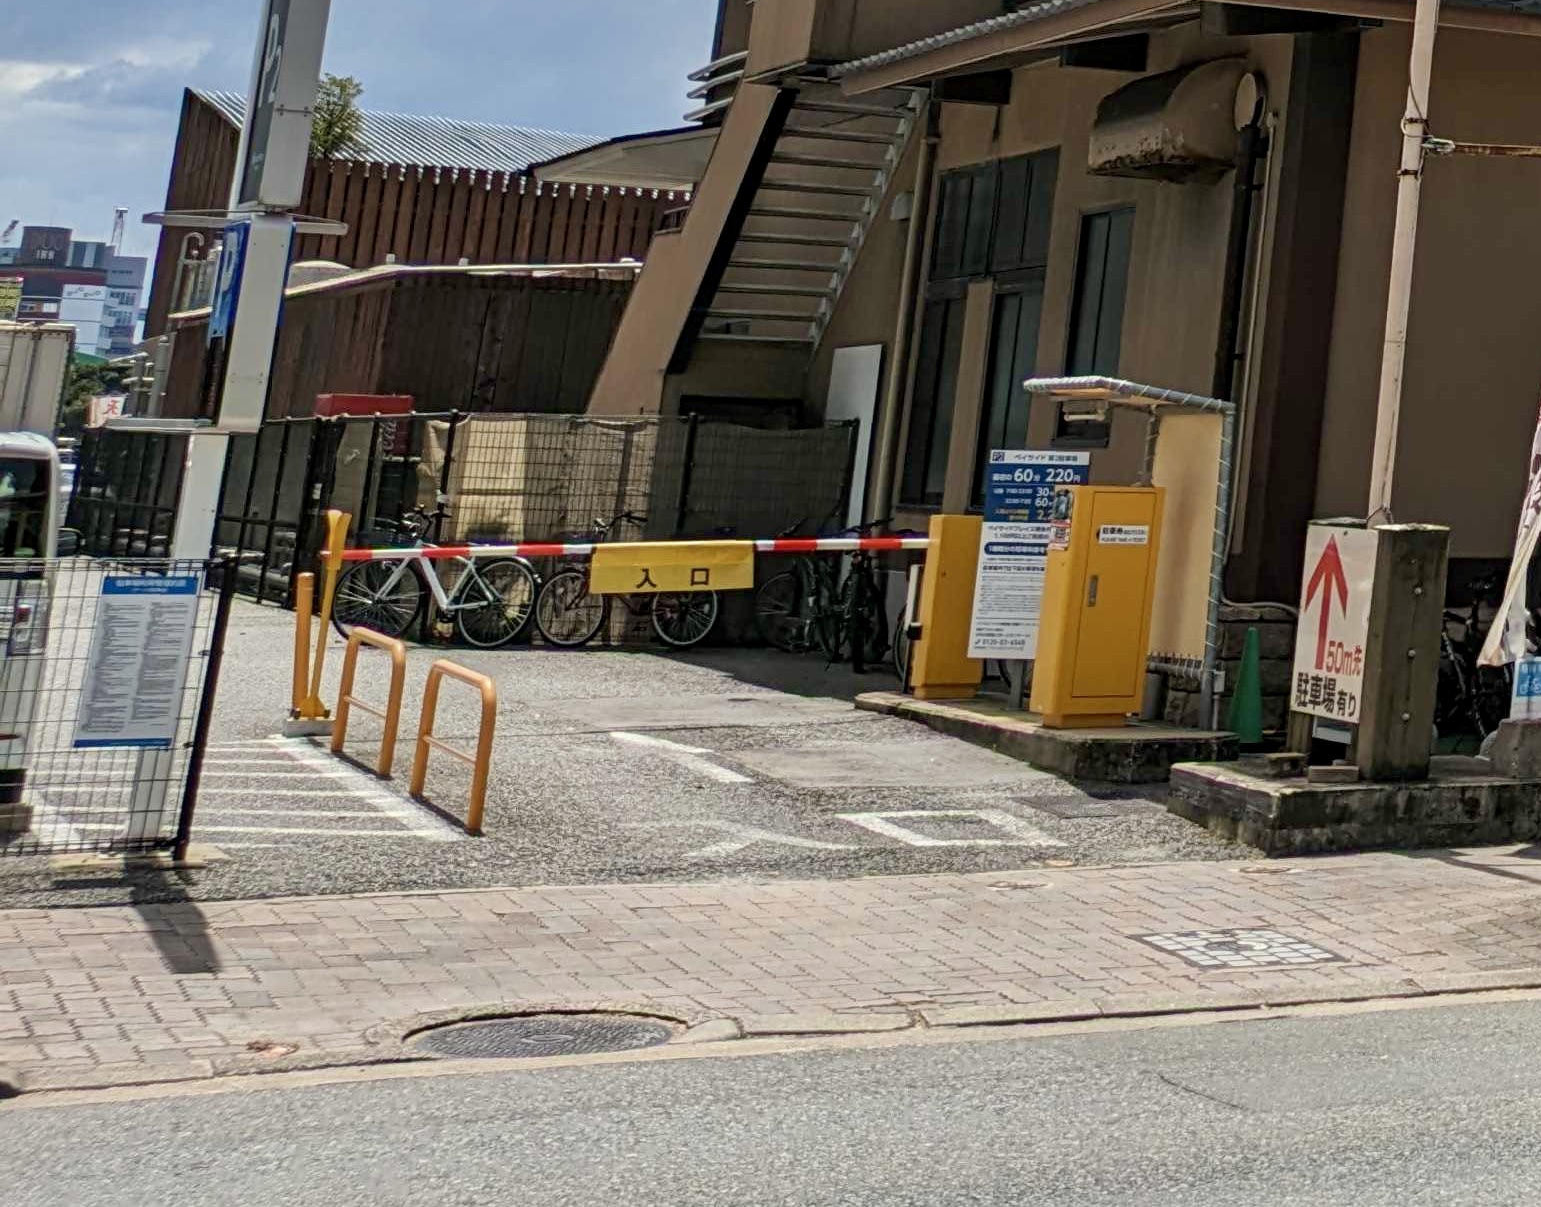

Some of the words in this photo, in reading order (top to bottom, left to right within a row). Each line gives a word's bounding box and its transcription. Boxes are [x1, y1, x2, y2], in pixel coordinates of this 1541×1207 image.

[636, 567, 710, 589] 入口
[1326, 640, 1362, 676] 50m先
[1295, 672, 1357, 717] 駐車場有り
